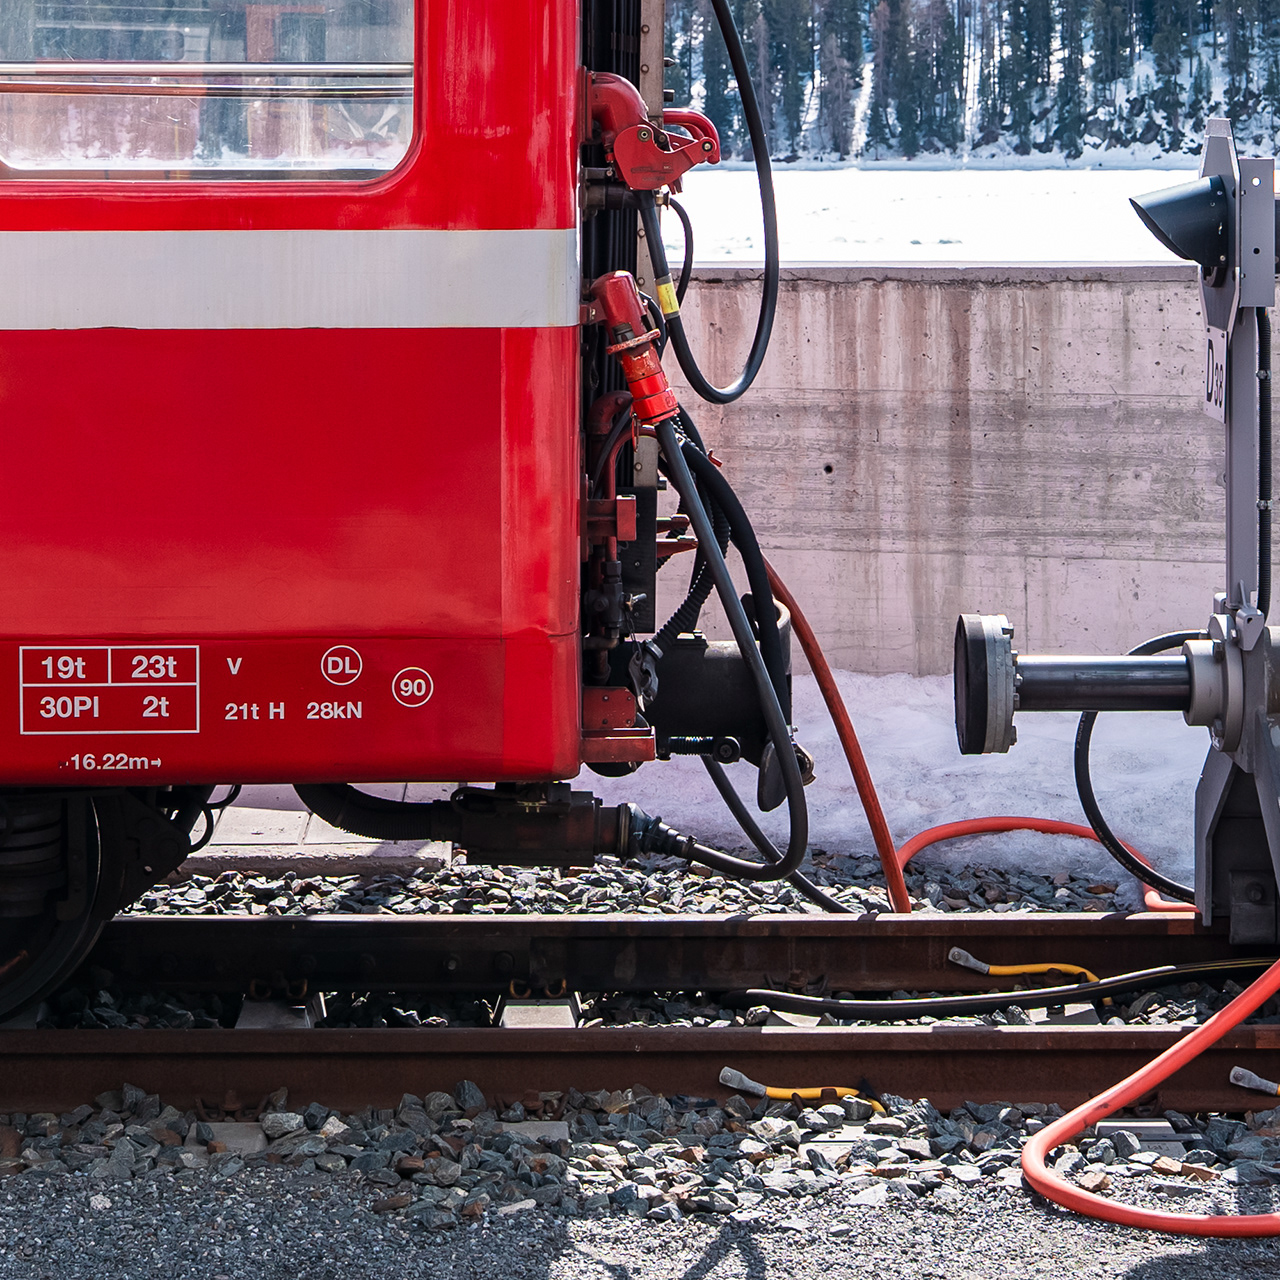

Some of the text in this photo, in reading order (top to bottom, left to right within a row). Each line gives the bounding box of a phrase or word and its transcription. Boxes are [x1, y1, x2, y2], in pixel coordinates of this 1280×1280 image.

[1206, 338, 1224, 409] D 38
[41, 655, 86, 679] 19t
[131, 655, 178, 679] 23t
[226, 657, 243, 675] V
[327, 656, 358, 674] DL
[399, 678, 426, 697] 90
[142, 695, 170, 718] 2t
[224, 701, 362, 720] 21t H 28kN
[70, 752, 149, 770] 16.22m
